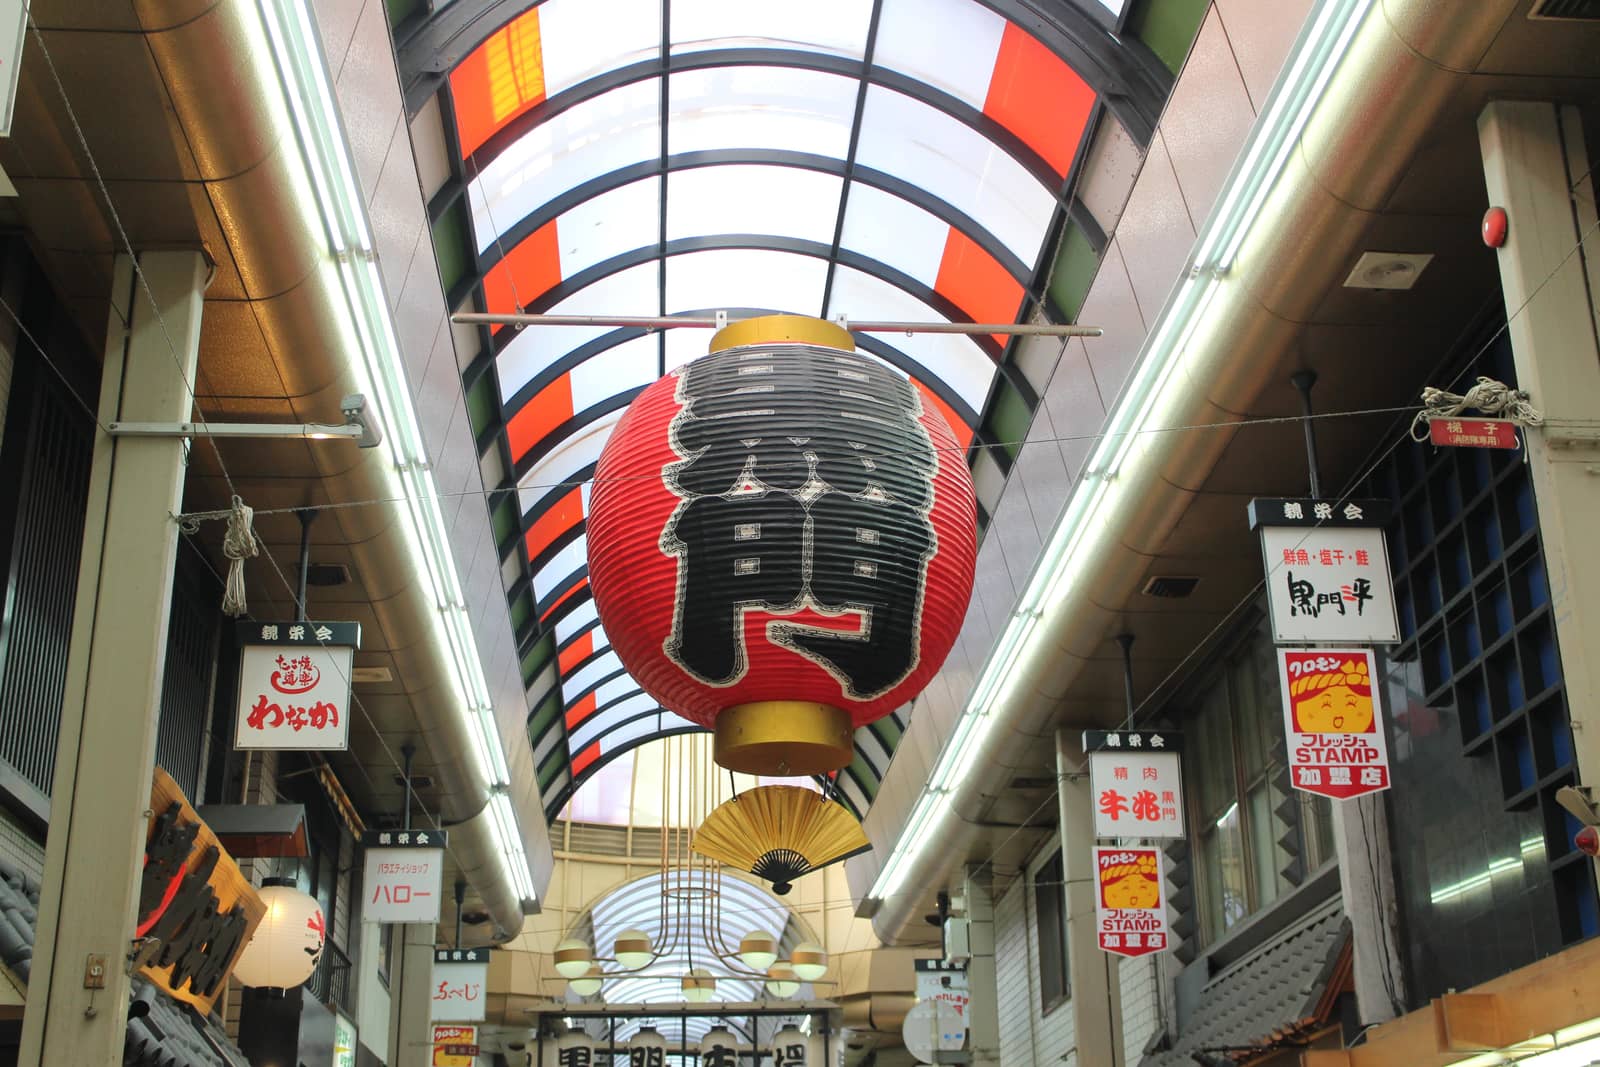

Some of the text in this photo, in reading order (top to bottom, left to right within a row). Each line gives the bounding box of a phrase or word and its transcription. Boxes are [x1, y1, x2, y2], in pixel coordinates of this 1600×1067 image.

[1287, 570, 1374, 618] 黒門三平
[1289, 657, 1341, 677] クロモン
[246, 694, 339, 732] わなか
[1301, 734, 1368, 747] フレッシュ
[1296, 748, 1379, 763] STAMP
[1113, 767, 1158, 780] 精肉
[1298, 767, 1382, 785] 加盟店
[1100, 852, 1137, 868] クロモン
[372, 885, 432, 904] ハロー
[1107, 909, 1154, 920] フレッシュ
[1102, 919, 1162, 931] STAMP
[1103, 934, 1163, 948] 加盟店
